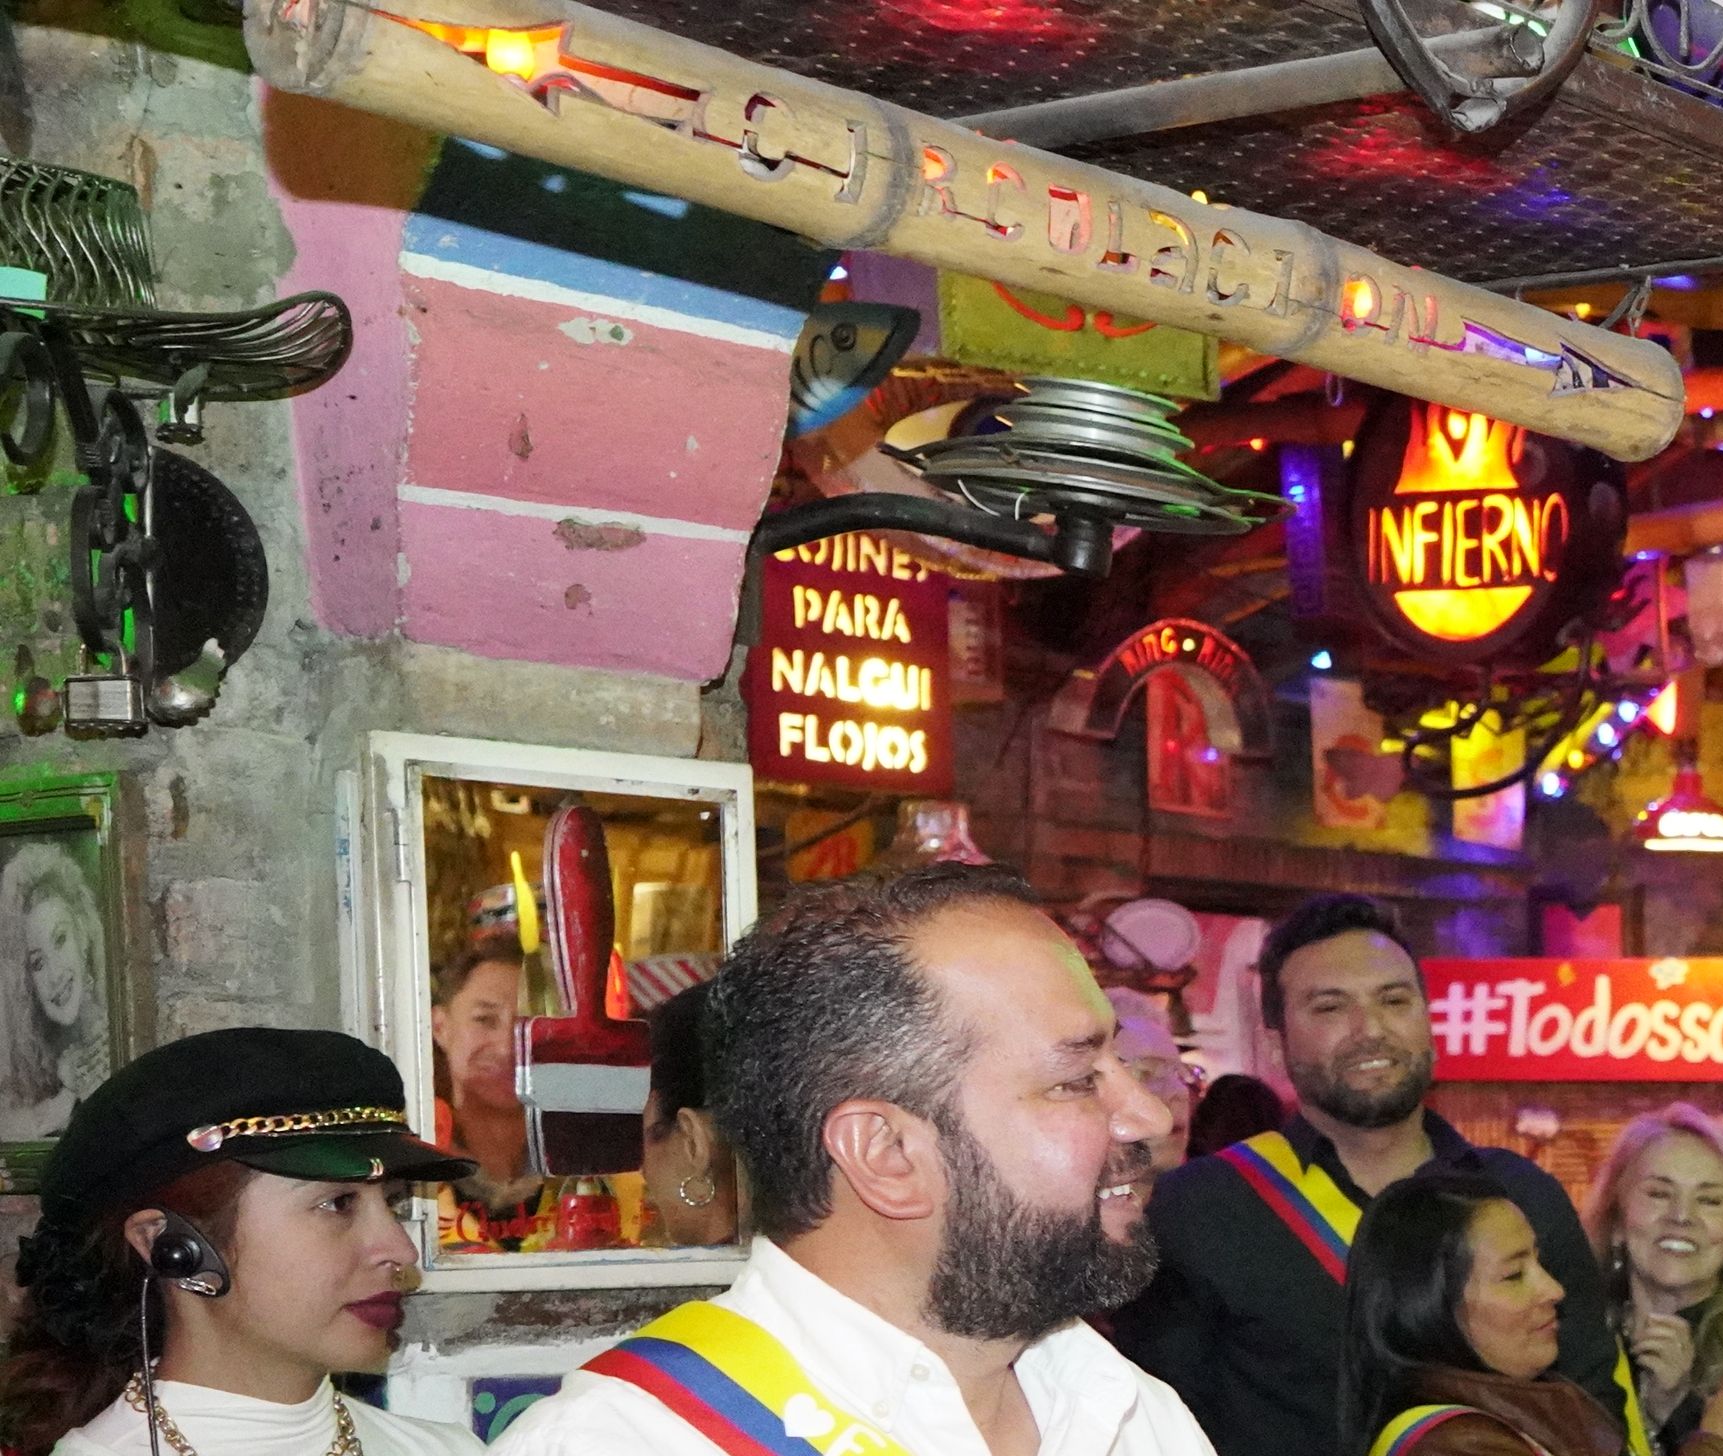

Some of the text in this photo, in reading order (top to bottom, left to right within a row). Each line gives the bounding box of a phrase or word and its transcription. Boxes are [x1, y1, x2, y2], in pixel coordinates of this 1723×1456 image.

[1367, 492, 1570, 587] INFIERNO
[792, 584, 912, 644] PARA
[771, 646, 932, 712] NALGUI
[778, 711, 928, 774] FLOJOS
